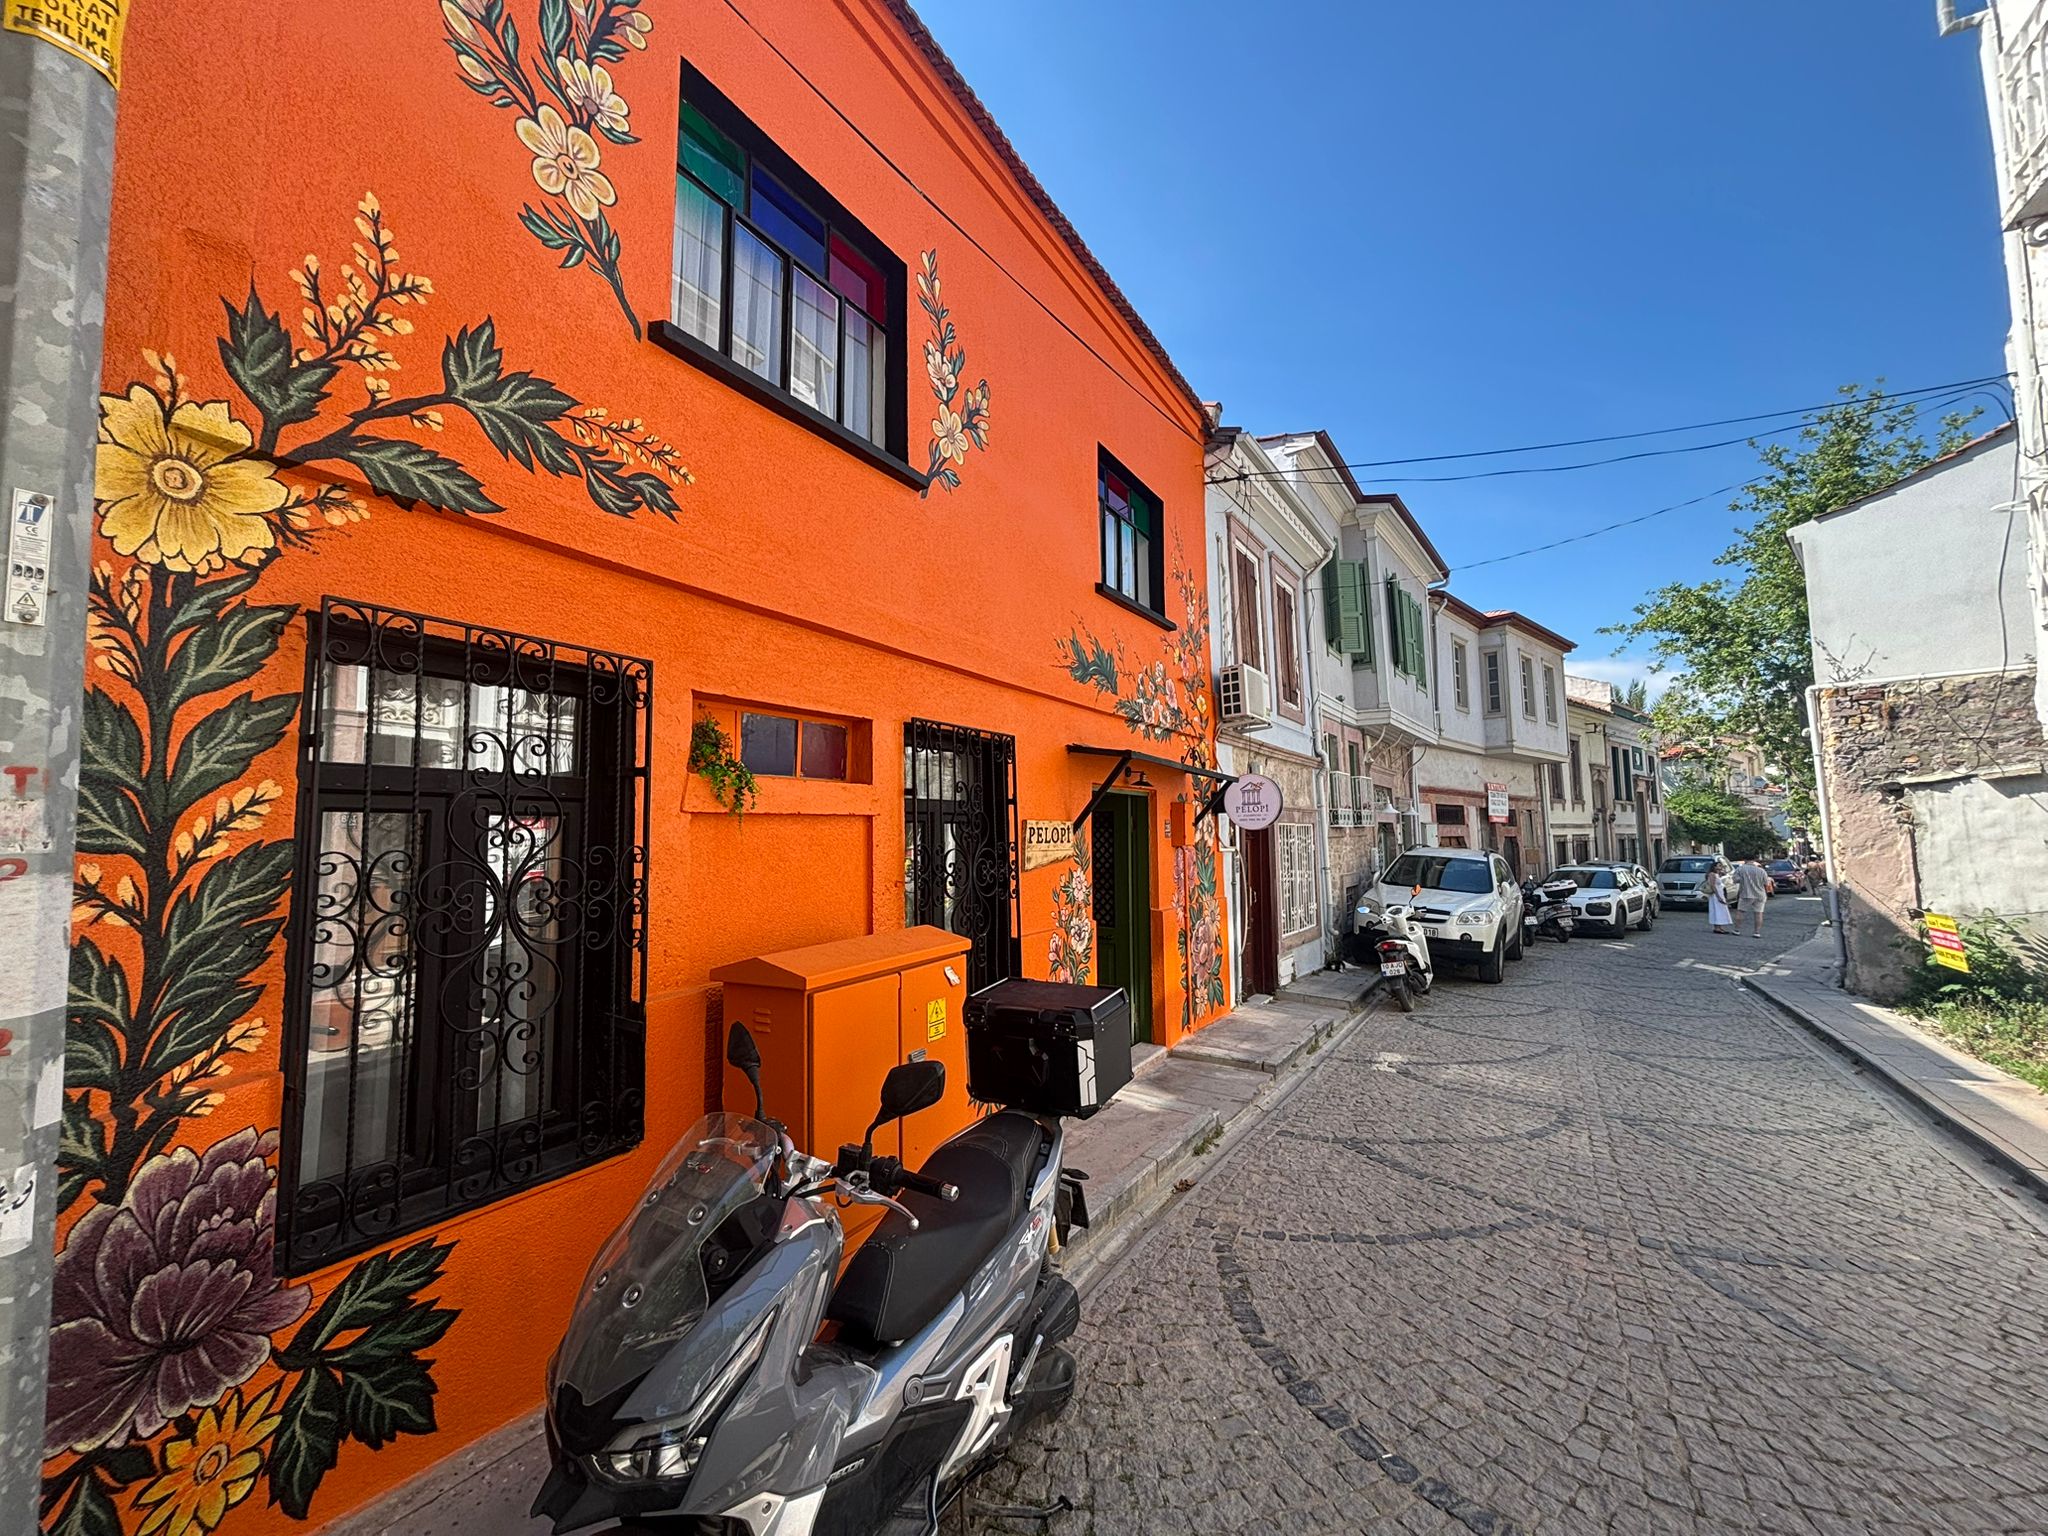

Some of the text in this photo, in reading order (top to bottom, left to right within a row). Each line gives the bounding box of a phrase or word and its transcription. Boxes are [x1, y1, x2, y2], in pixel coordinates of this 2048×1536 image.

[16, 4, 111, 63] TEHLİKE
[1235, 804, 1269, 813] PELOPİ
[1028, 825, 1071, 844] PELOPİ
